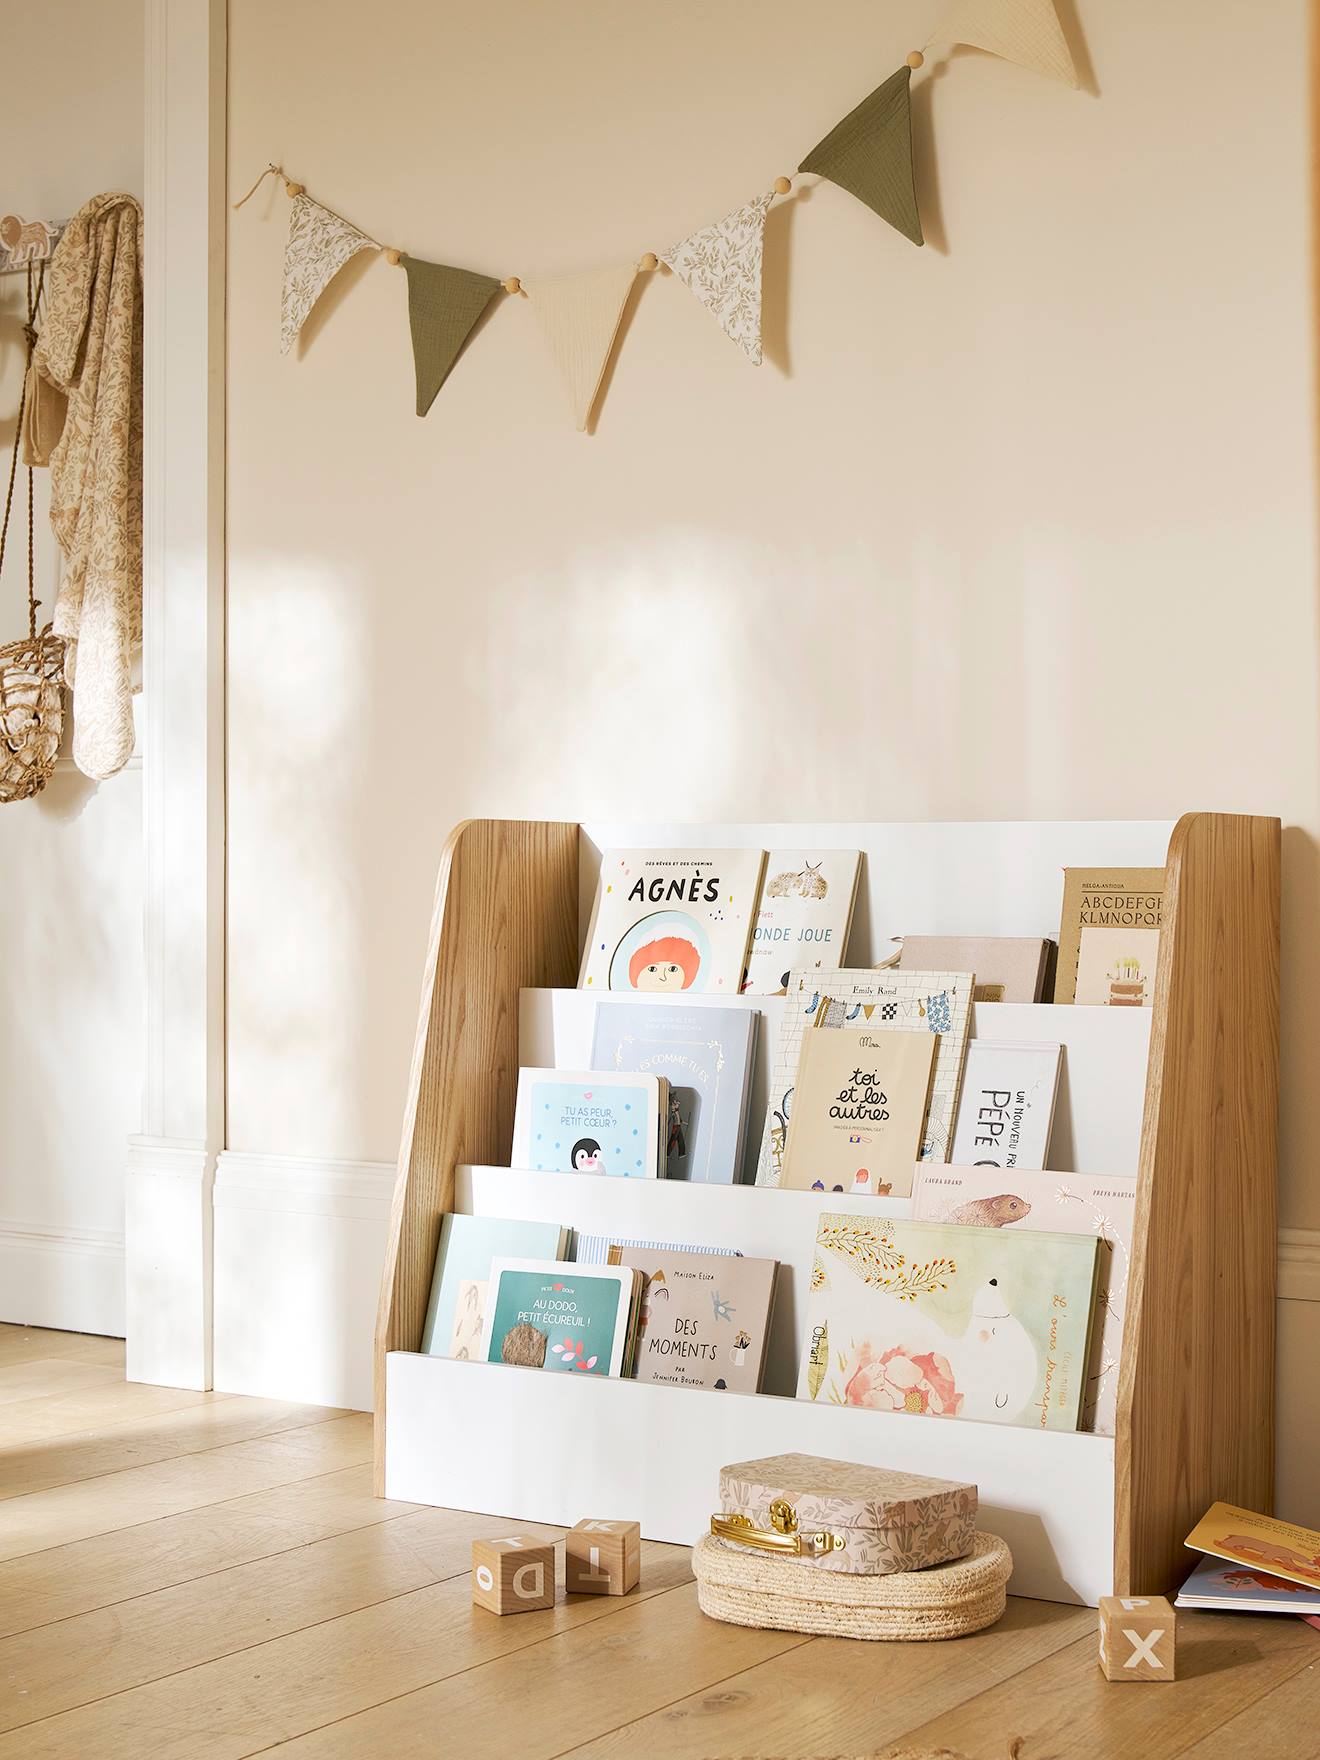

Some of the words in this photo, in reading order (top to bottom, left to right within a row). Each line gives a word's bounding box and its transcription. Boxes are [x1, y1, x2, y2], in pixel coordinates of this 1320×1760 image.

[627, 869, 721, 902] AGNÈS
[797, 928, 833, 942] JOUE
[852, 985, 874, 997] Emily
[877, 986, 898, 996] Rand
[848, 1067, 881, 1086] toi
[836, 1086, 859, 1104] et
[860, 1086, 888, 1105] les
[1013, 1091, 1025, 1104] UN
[565, 1106, 576, 1116] TU
[577, 1107, 589, 1117] AS
[829, 1104, 890, 1121] autres
[974, 1089, 1011, 1147] PÉPÉ
[560, 1116, 581, 1127] PETIT
[612, 1119, 617, 1129] ?
[1009, 1107, 1023, 1150] NOUVEAU
[673, 1271, 697, 1279] MAISON
[533, 1299, 547, 1309] AU
[548, 1301, 578, 1314] DODO,
[517, 1311, 541, 1322] PETIT
[542, 1311, 585, 1327] ÉCUREUIL
[587, 1317, 592, 1327] !
[674, 1318, 699, 1336] DES
[648, 1338, 718, 1361] MOMENTS
[512, 1562, 544, 1599] D
[1121, 1629, 1166, 1668] X
